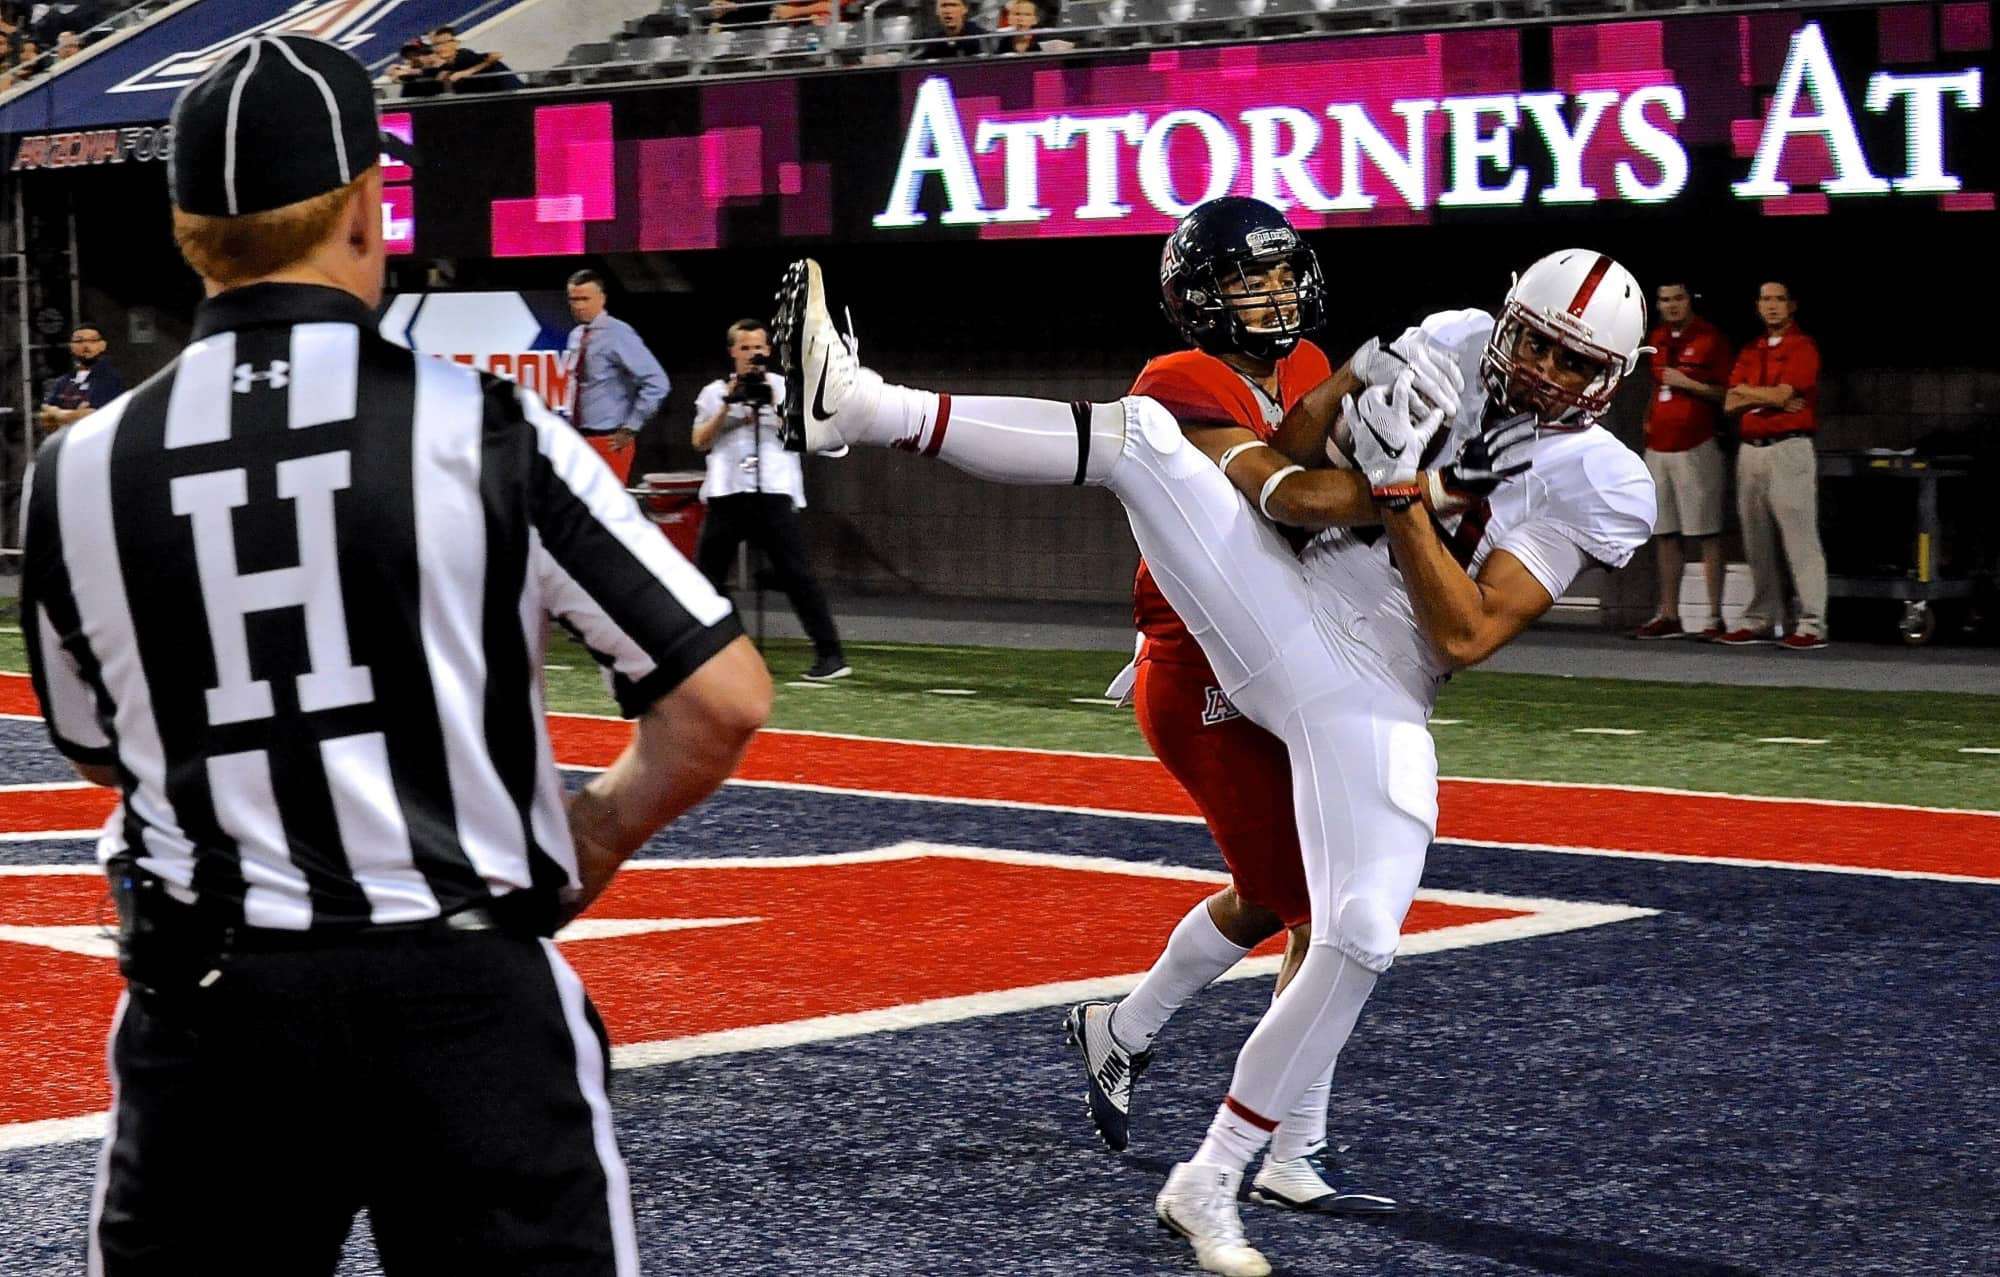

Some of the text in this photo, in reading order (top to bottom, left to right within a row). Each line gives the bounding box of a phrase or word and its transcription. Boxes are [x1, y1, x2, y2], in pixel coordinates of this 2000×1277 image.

[874, 21, 1982, 227] ATTORNEYS AT
[170, 449, 376, 726] H
[1201, 685, 1241, 726] A
